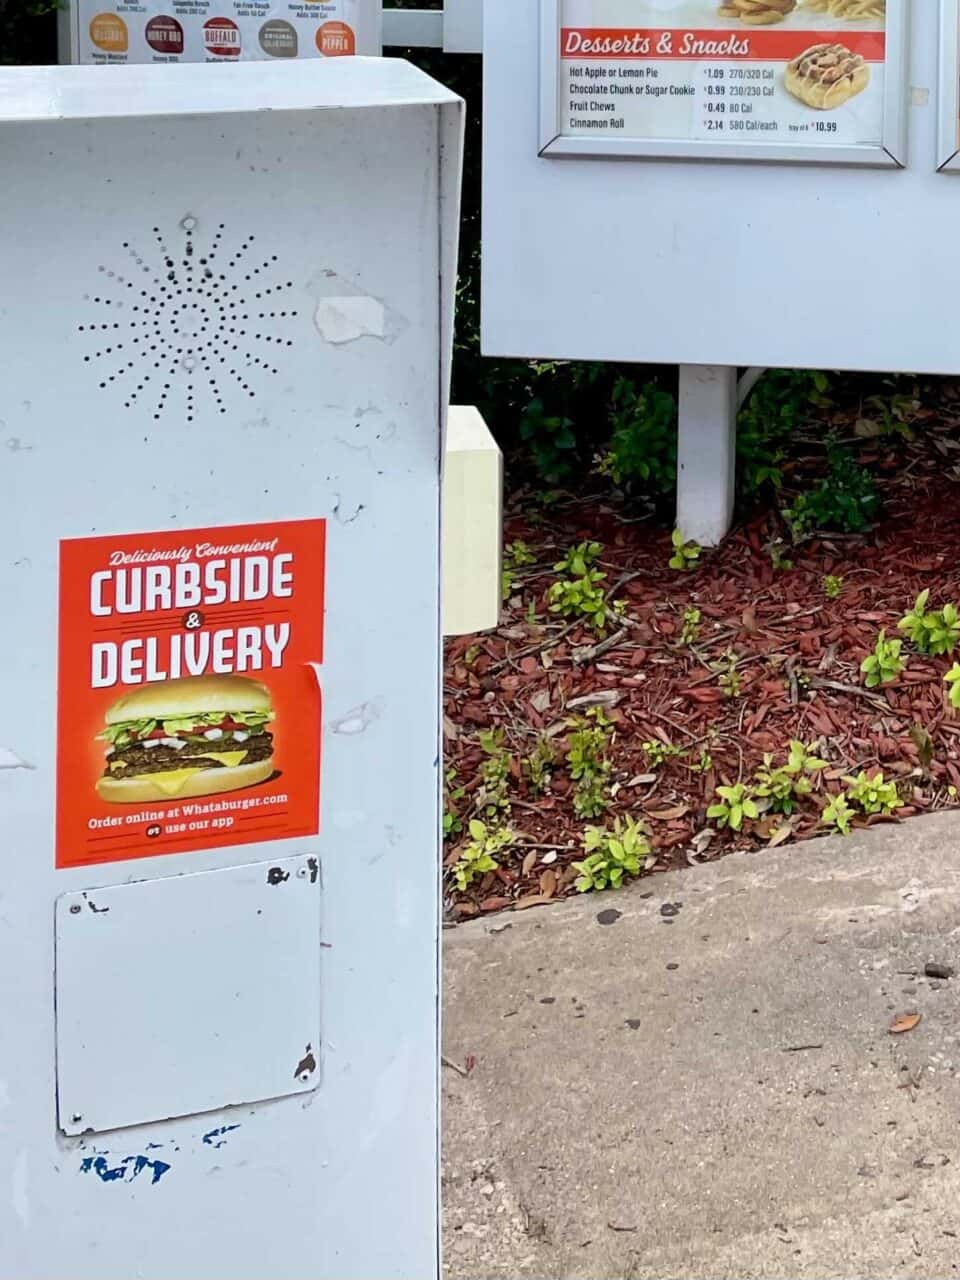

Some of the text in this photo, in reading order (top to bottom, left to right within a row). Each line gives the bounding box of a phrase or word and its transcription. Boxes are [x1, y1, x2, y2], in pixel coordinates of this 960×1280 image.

[565, 33, 749, 55] Desserts & Snacks
[569, 84, 695, 97] Chocolate Chunk Sugar Cookie
[569, 101, 615, 112] Fruit Chews
[569, 118, 608, 129] Cinnamon
[109, 538, 278, 566] Deliciously Convenient
[90, 553, 293, 616] CURBSIDE
[187, 612, 200, 628] &
[91, 623, 290, 688] DELIVERY
[89, 794, 288, 829] Order online at Whataburger.com
[166, 816, 234, 834] use our app
